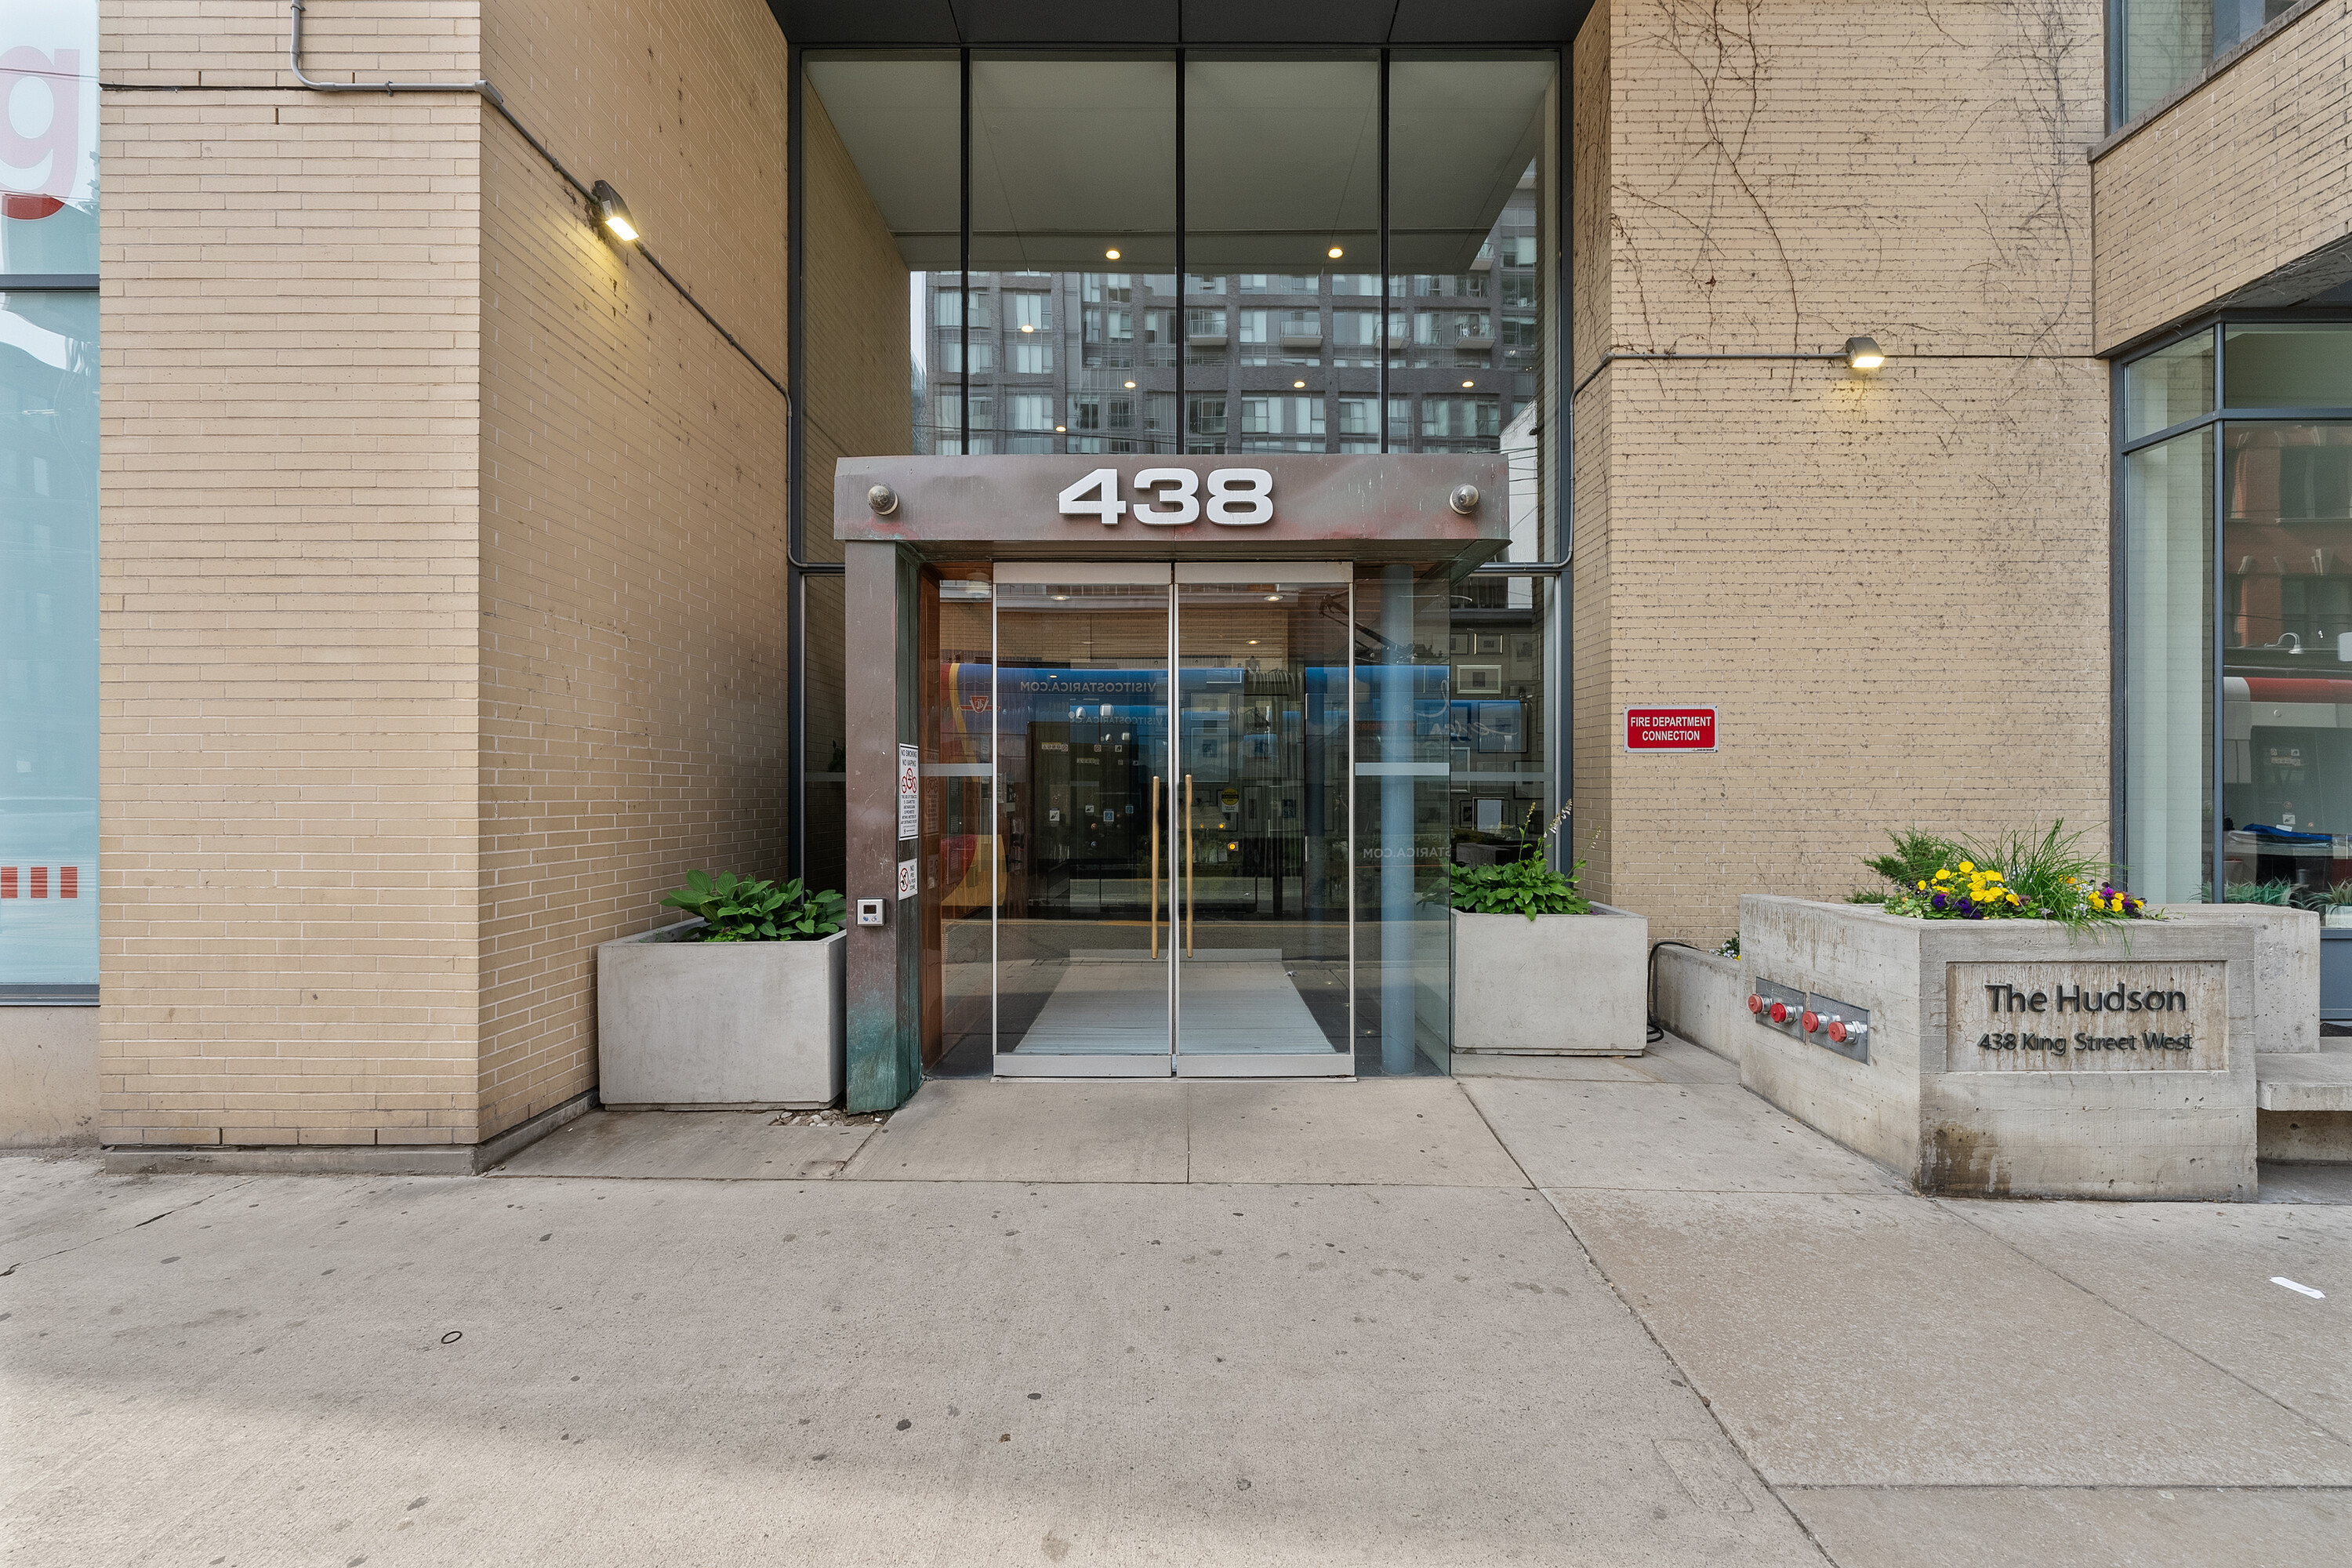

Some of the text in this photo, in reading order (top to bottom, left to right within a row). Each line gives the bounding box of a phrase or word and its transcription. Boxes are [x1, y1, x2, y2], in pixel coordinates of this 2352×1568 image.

[1058, 468, 1274, 526] 438
[1631, 717, 1711, 727] FIRE DEPARTMENT
[1642, 731, 1700, 741] CONNECTION
[1984, 982, 2187, 1012] The Hudson
[1976, 1032, 2194, 1056] 438 King Street West
